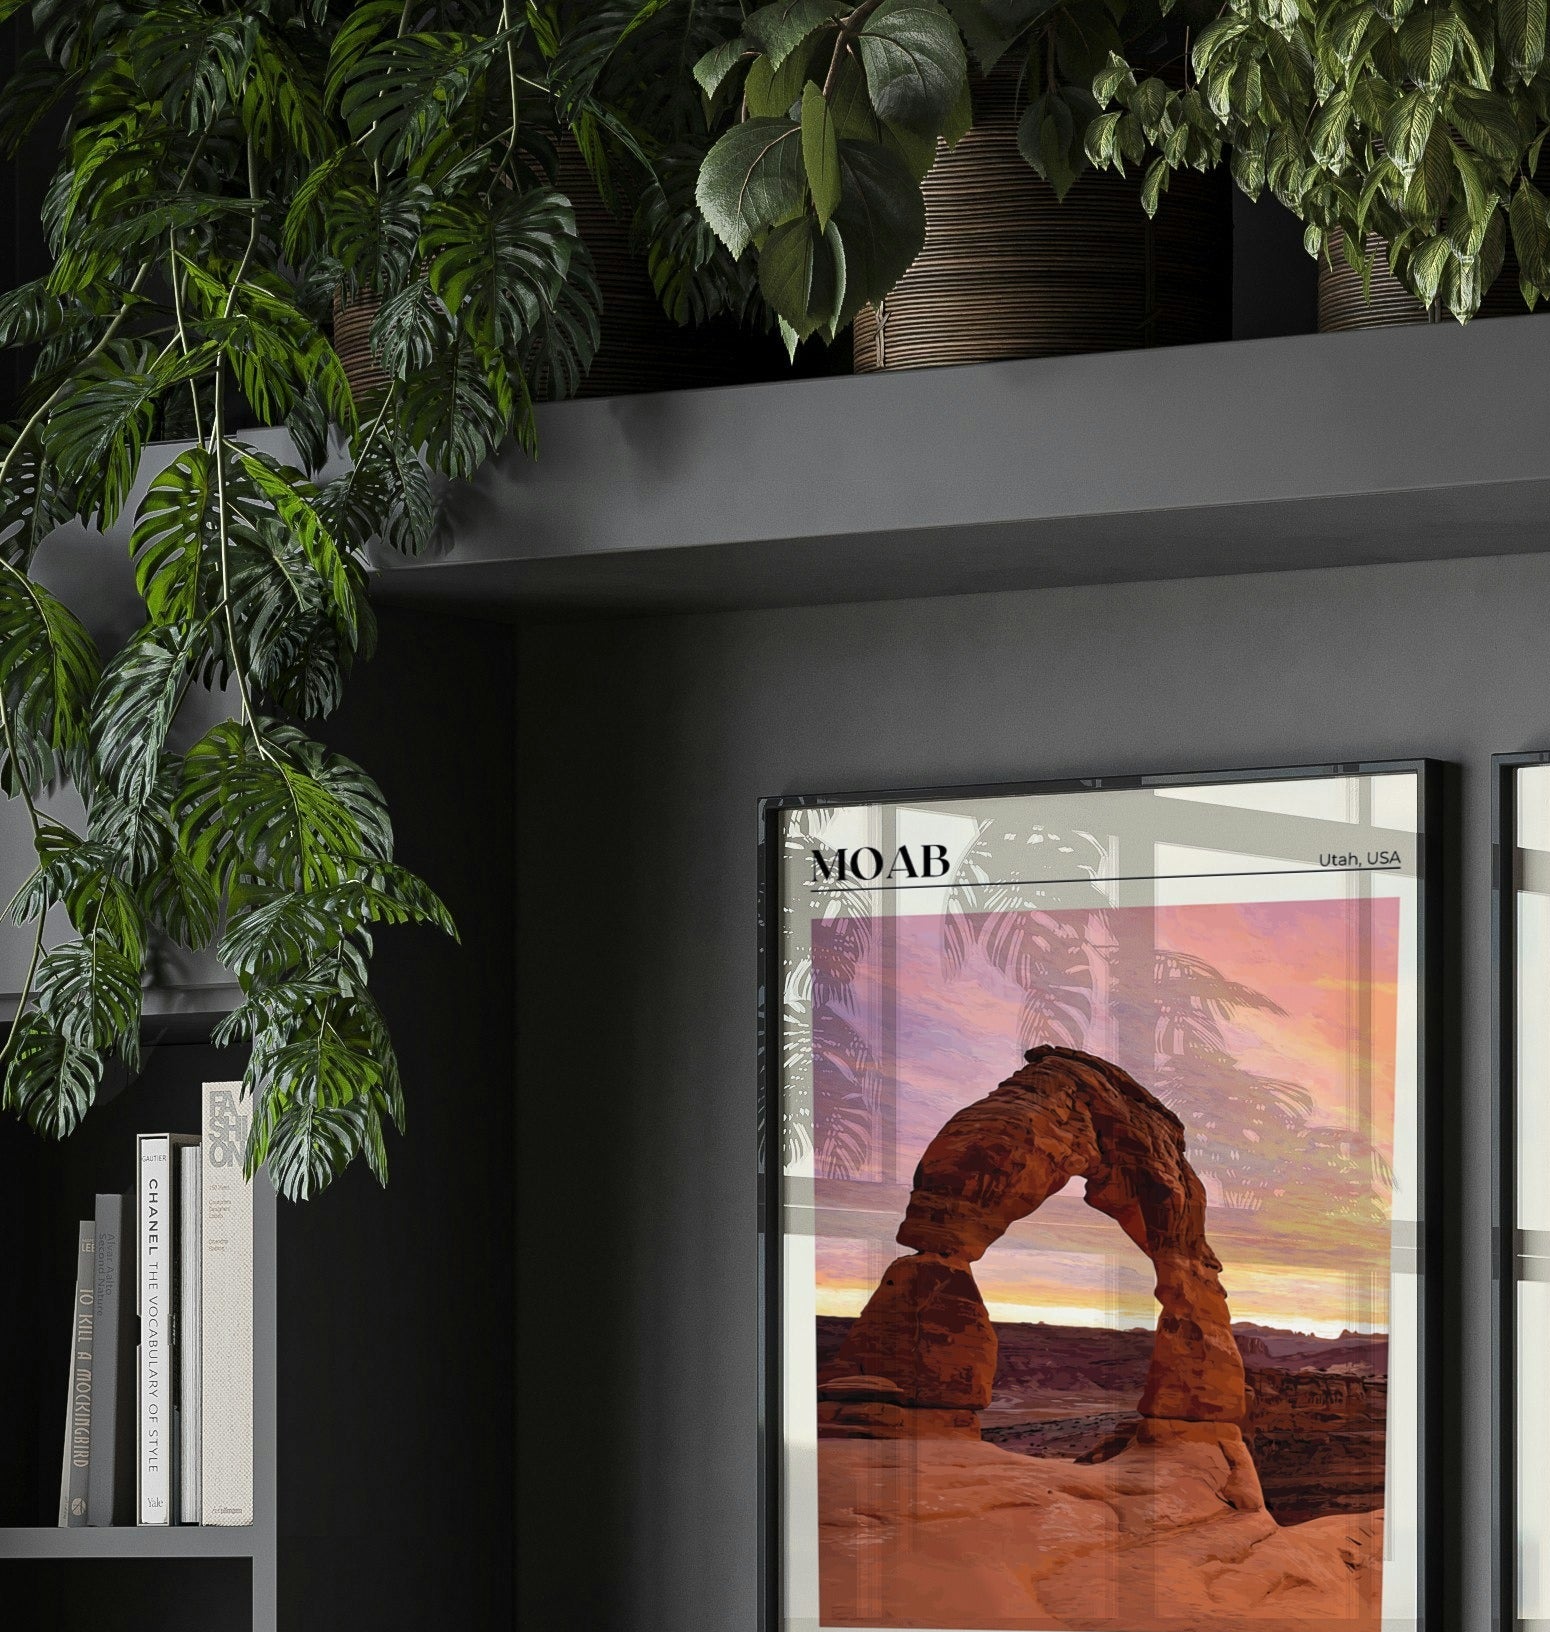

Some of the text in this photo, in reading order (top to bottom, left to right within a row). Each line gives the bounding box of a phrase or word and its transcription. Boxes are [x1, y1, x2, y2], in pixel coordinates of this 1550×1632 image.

[811, 844, 951, 882] MOAB
[1319, 850, 1401, 868] Utah, USA
[142, 1154, 167, 1163] GAUTIER
[97, 1233, 106, 1316] Second Nature
[105, 1233, 116, 1296] Alvar Aalto
[77, 1314, 93, 1343] KILL
[148, 1178, 158, 1472] CHANEL THE VOCABULARY OF STYLE
[77, 1351, 92, 1360] A
[73, 1368, 92, 1468] MOCKINGBIRD
[146, 1496, 164, 1508] Yale
